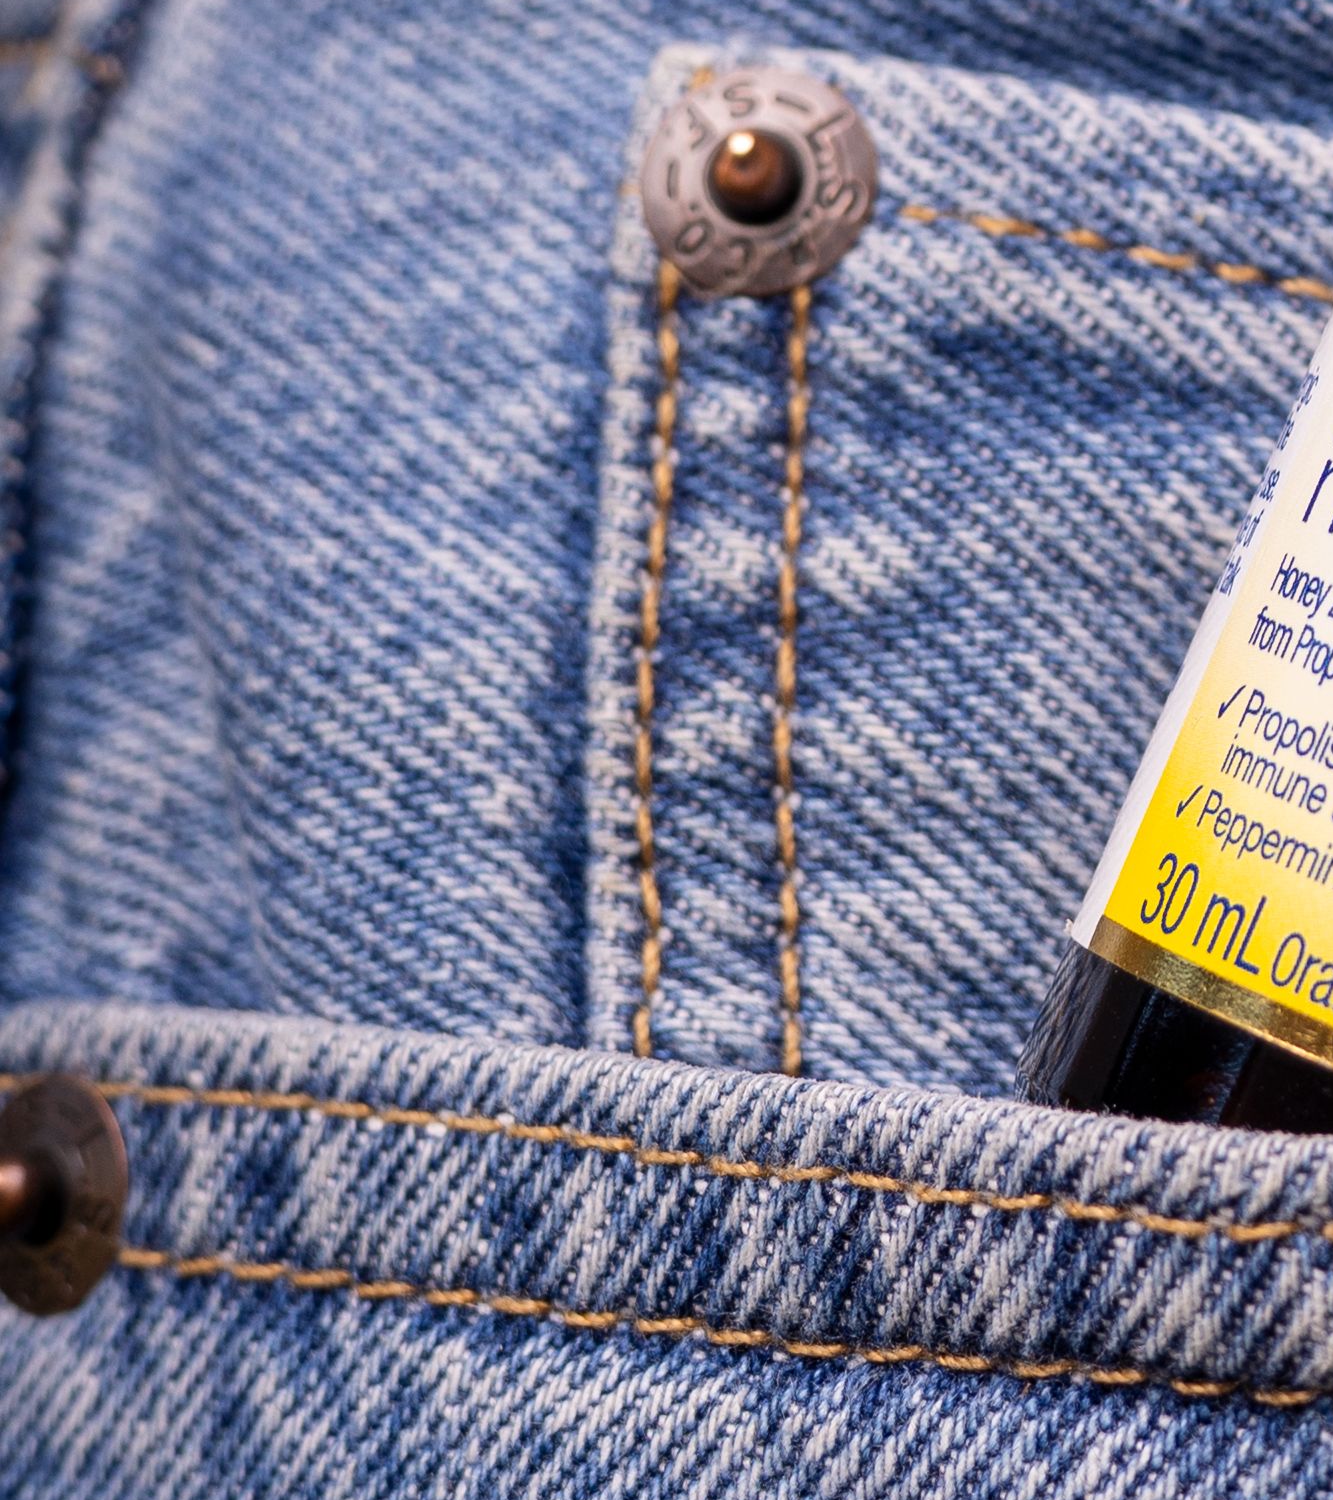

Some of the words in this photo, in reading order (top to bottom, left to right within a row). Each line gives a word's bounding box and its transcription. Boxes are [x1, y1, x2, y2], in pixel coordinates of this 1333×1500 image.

[1270, 553, 1332, 618] Honey
[1248, 606, 1293, 658] from
[1220, 736, 1328, 812] immune
[1140, 852, 1201, 935] 30
[1191, 892, 1267, 976] mL
